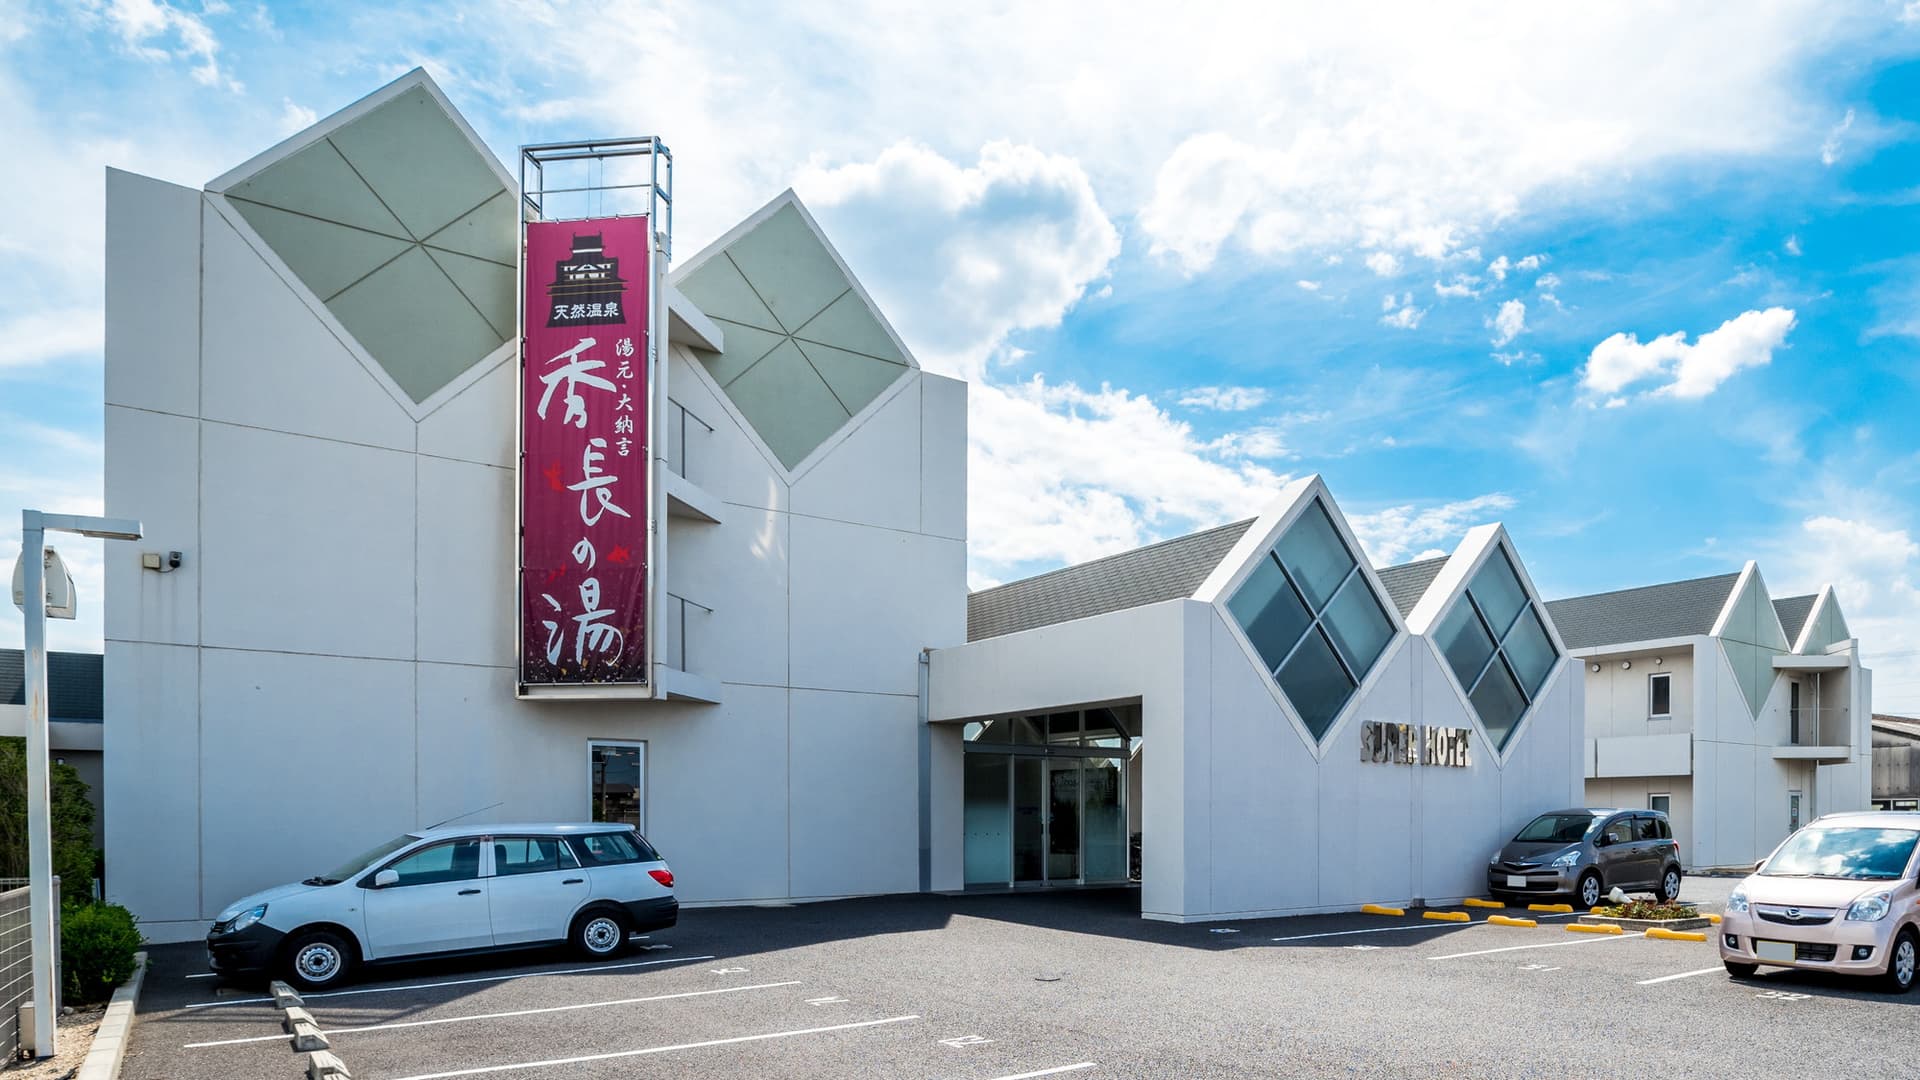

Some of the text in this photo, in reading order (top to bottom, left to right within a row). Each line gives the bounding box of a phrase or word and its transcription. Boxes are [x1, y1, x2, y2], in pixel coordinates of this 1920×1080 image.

[553, 301, 619, 320] 天然温泉
[537, 337, 632, 666] 香長の湯
[1360, 720, 1473, 767] SUPER HOTEL
